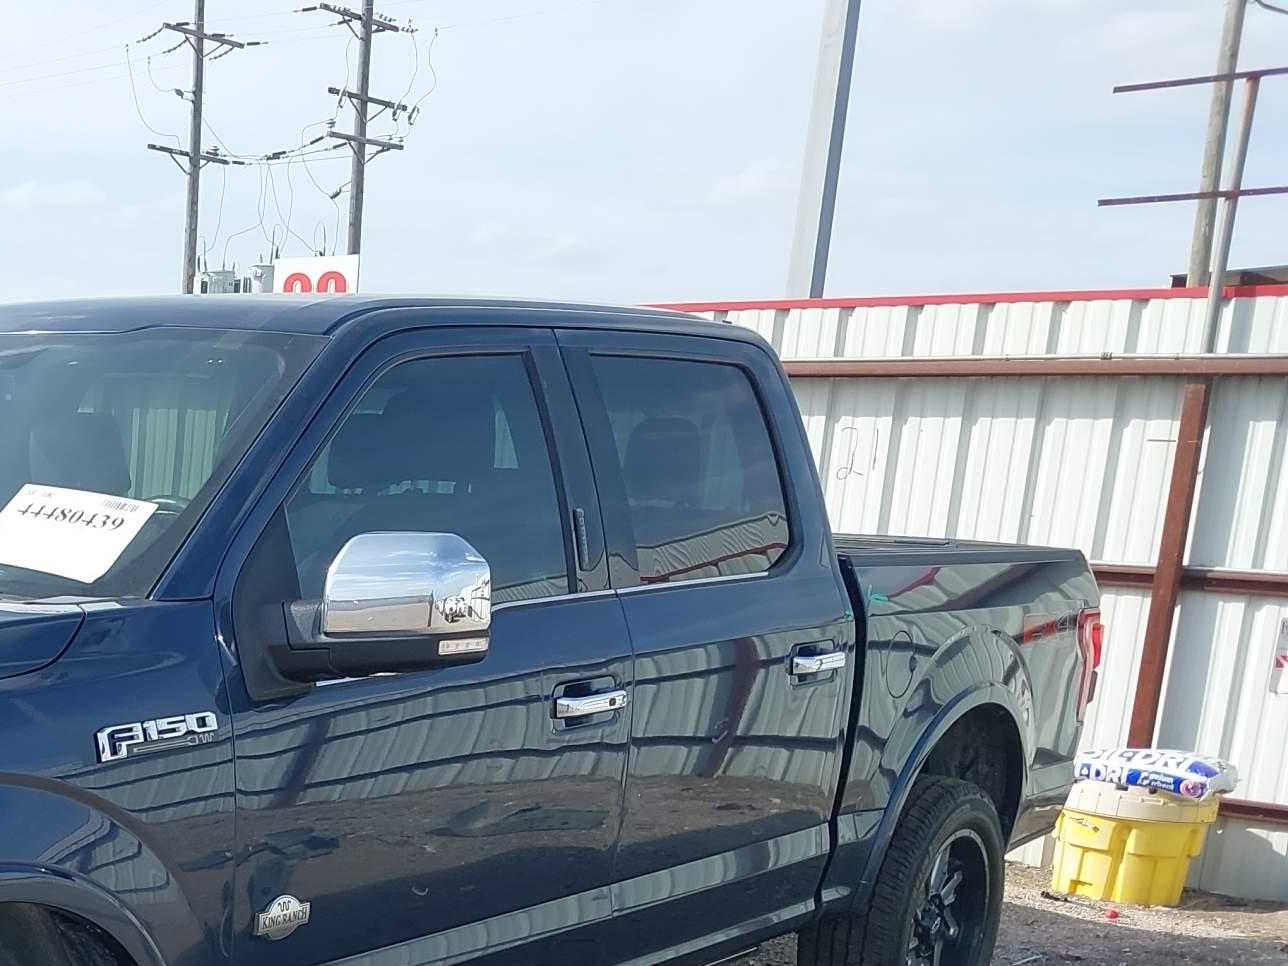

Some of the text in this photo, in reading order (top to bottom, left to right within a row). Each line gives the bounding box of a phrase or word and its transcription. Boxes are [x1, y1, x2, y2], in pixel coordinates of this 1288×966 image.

[17, 503, 125, 531] 44480439
[262, 906, 307, 929] KING RANCH
